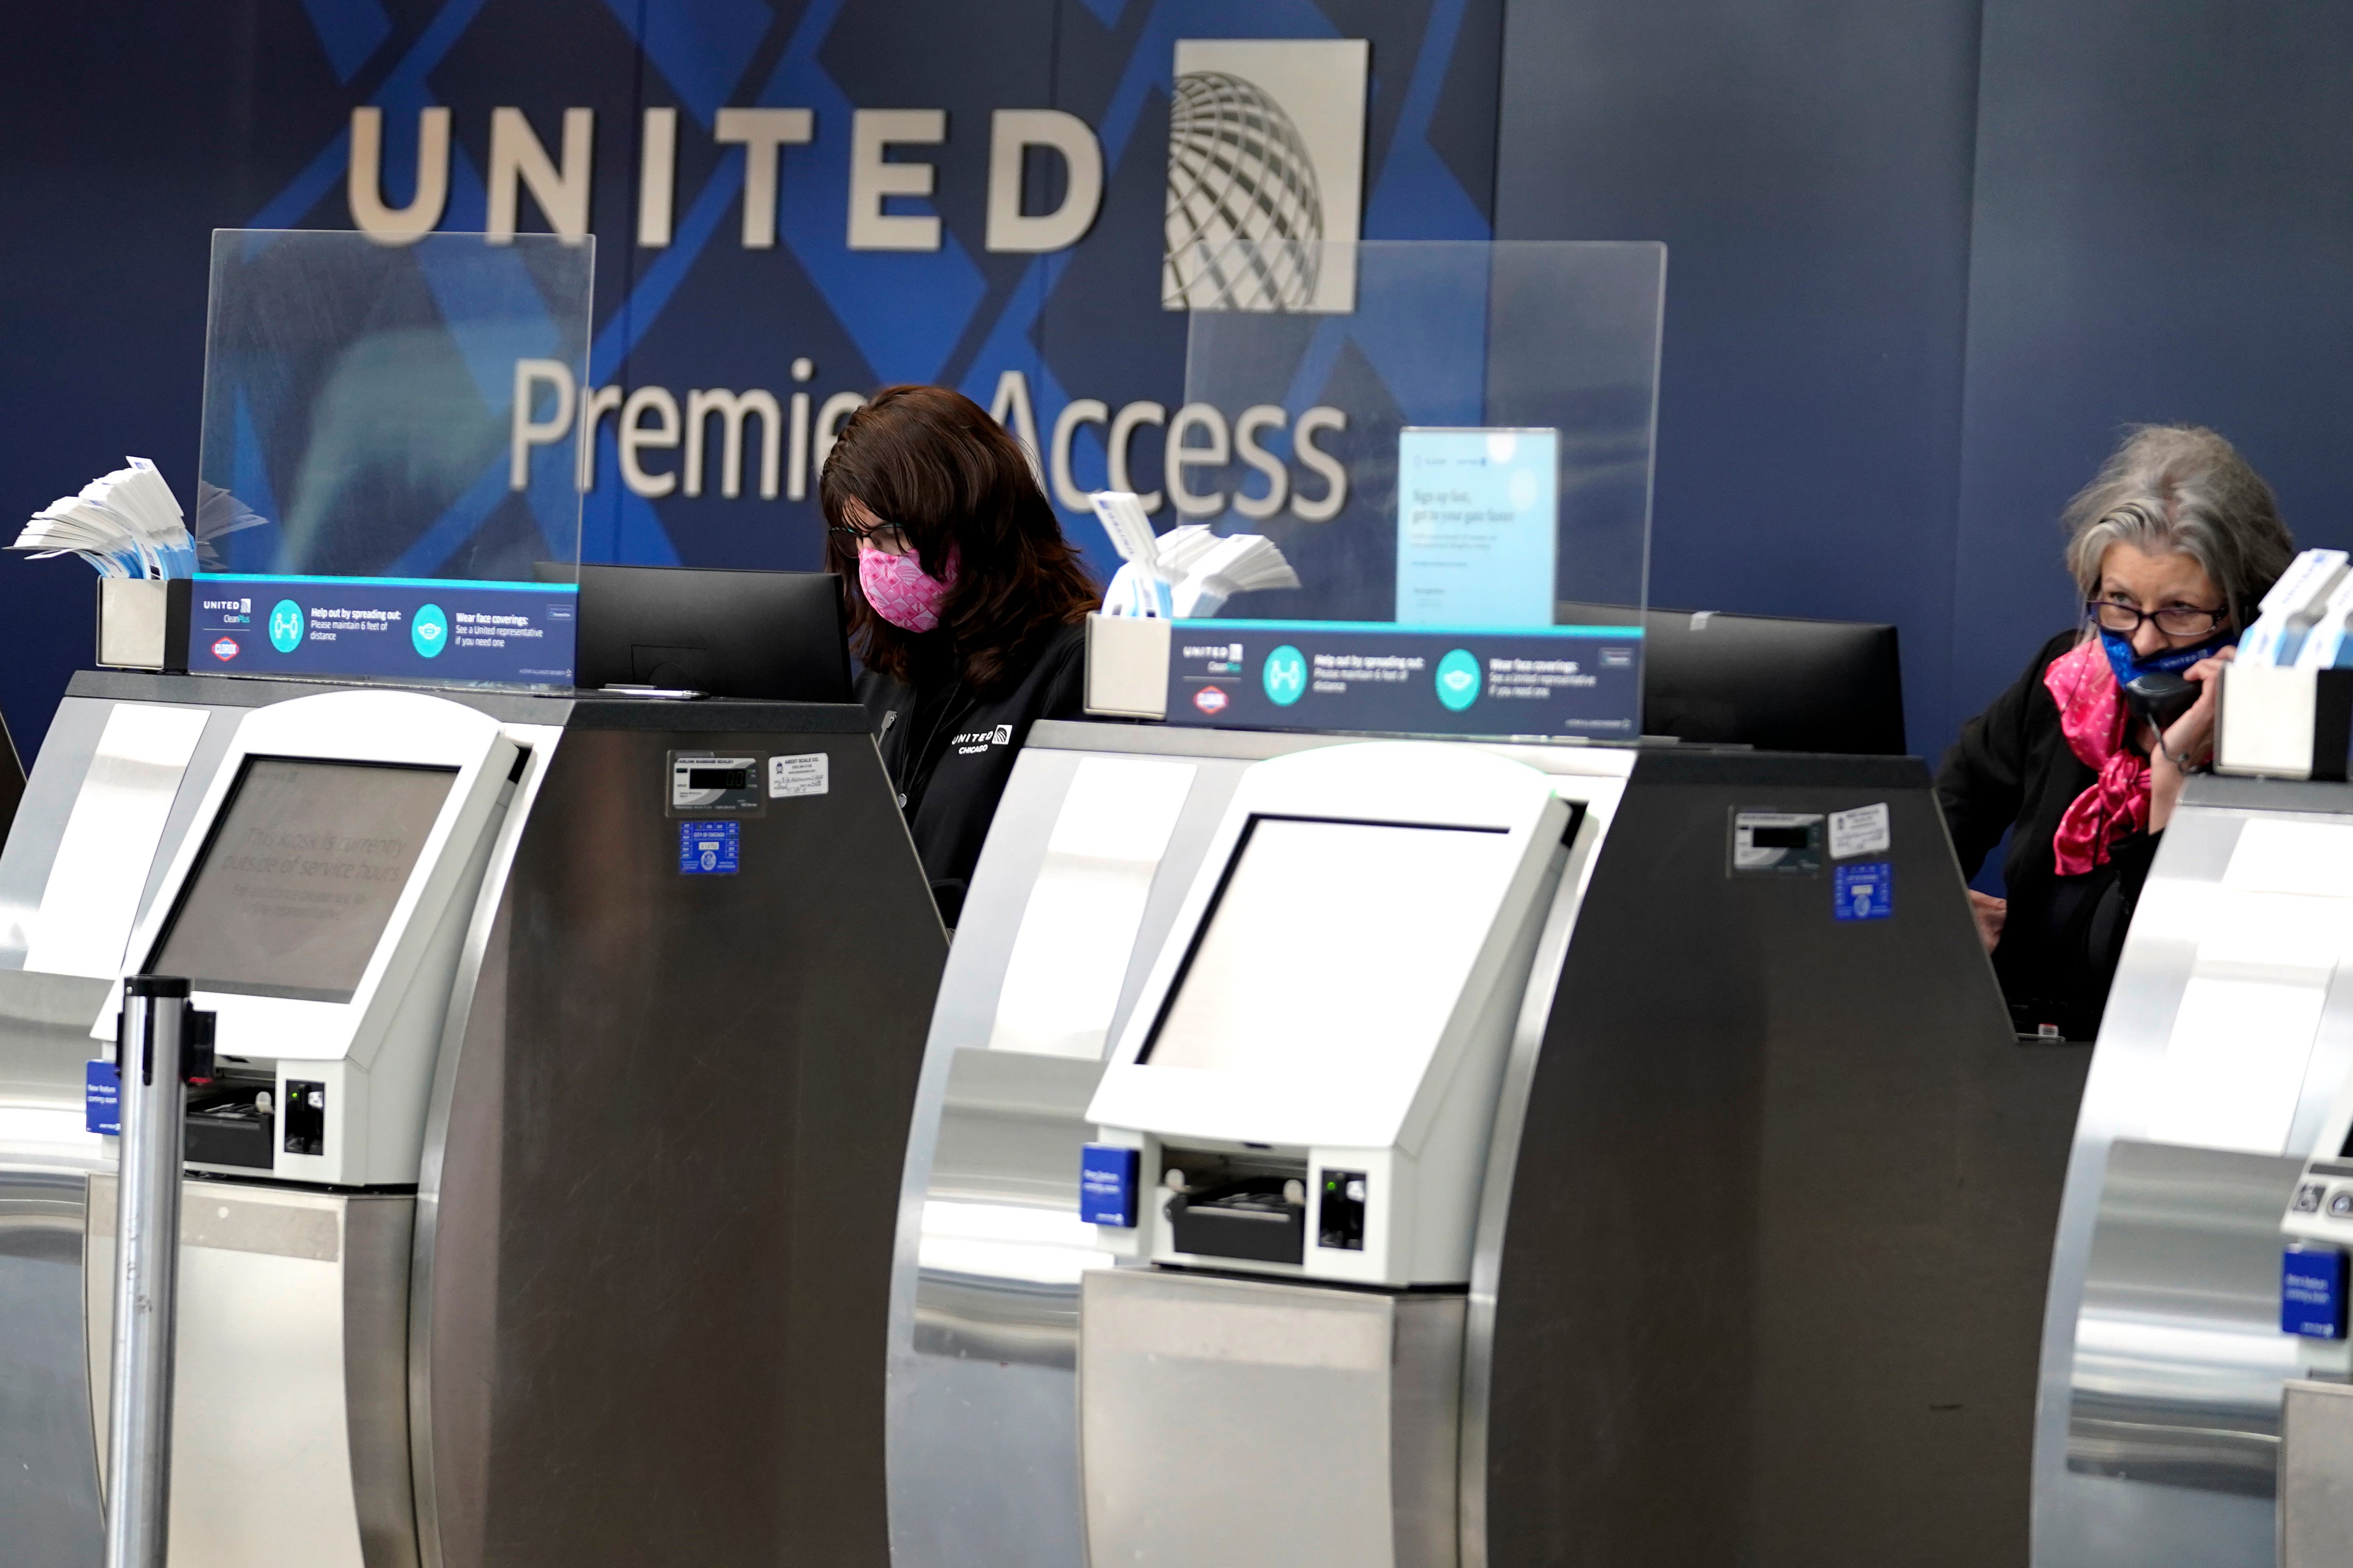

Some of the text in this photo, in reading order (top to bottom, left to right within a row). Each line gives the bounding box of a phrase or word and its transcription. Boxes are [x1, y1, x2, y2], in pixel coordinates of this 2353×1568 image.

[347, 106, 1104, 250] UNITED
[509, 356, 1348, 522] Premie Access
[203, 600, 240, 610] UNITED
[223, 614, 250, 624] CleanPlus
[311, 608, 402, 621] Help out by spreading out:
[456, 612, 529, 627] Wear face coverings:
[311, 619, 388, 631] Please maintain 6 feet of
[455, 625, 468, 634] See
[473, 626, 496, 635] United
[496, 628, 544, 638] representative
[310, 630, 336, 641] distance
[454, 636, 505, 647] if you need one
[1183, 645, 1228, 658] UNITED
[951, 731, 994, 745] UNITED
[959, 744, 988, 754] CHICAGO
[279, 855, 300, 875] of
